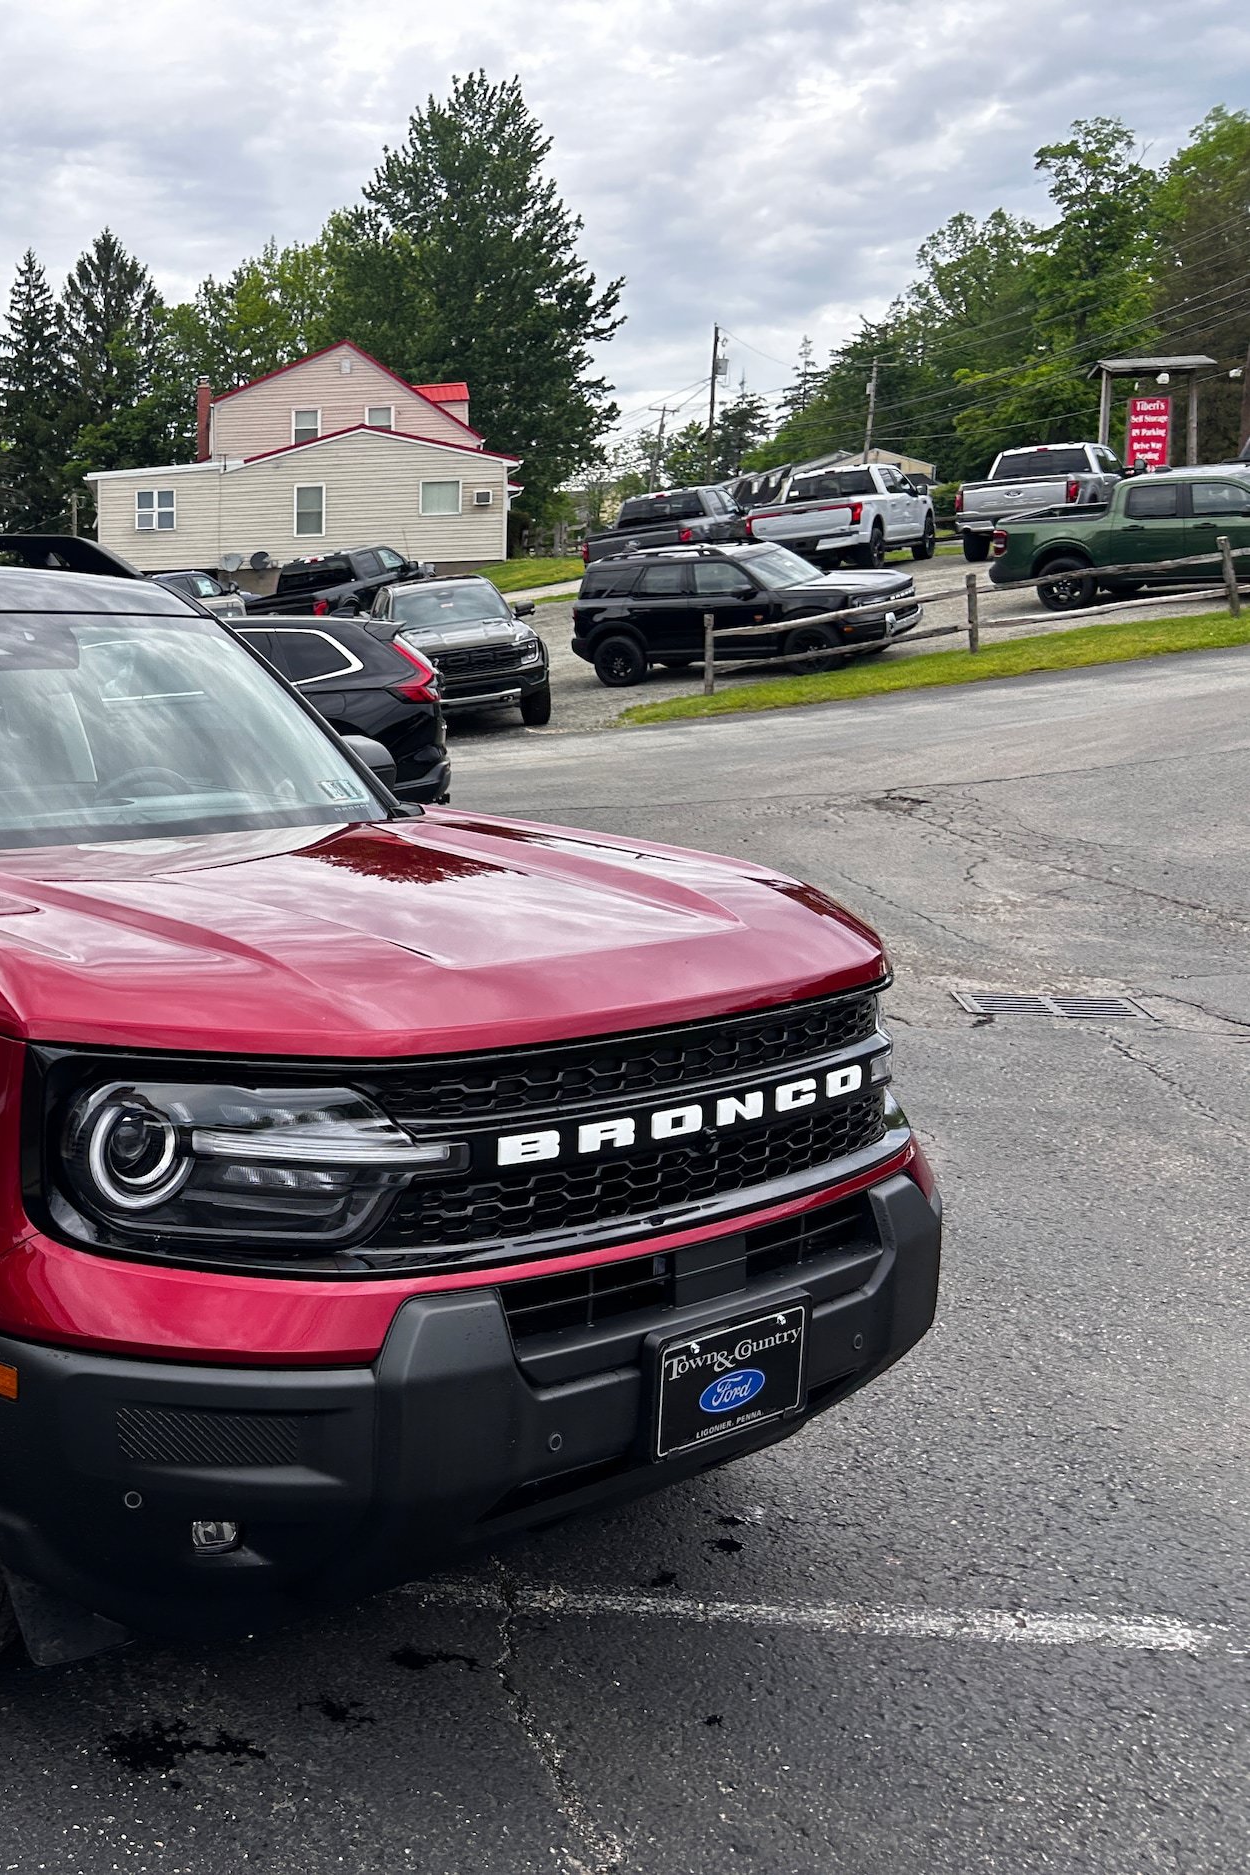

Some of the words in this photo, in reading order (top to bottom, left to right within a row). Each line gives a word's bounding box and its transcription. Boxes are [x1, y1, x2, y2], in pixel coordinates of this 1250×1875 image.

[1141, 428, 1166, 437] Parking
[1134, 442, 1149, 450] Drive
[497, 1064, 863, 1167] BRONCO
[711, 1375, 753, 1407] Ford
